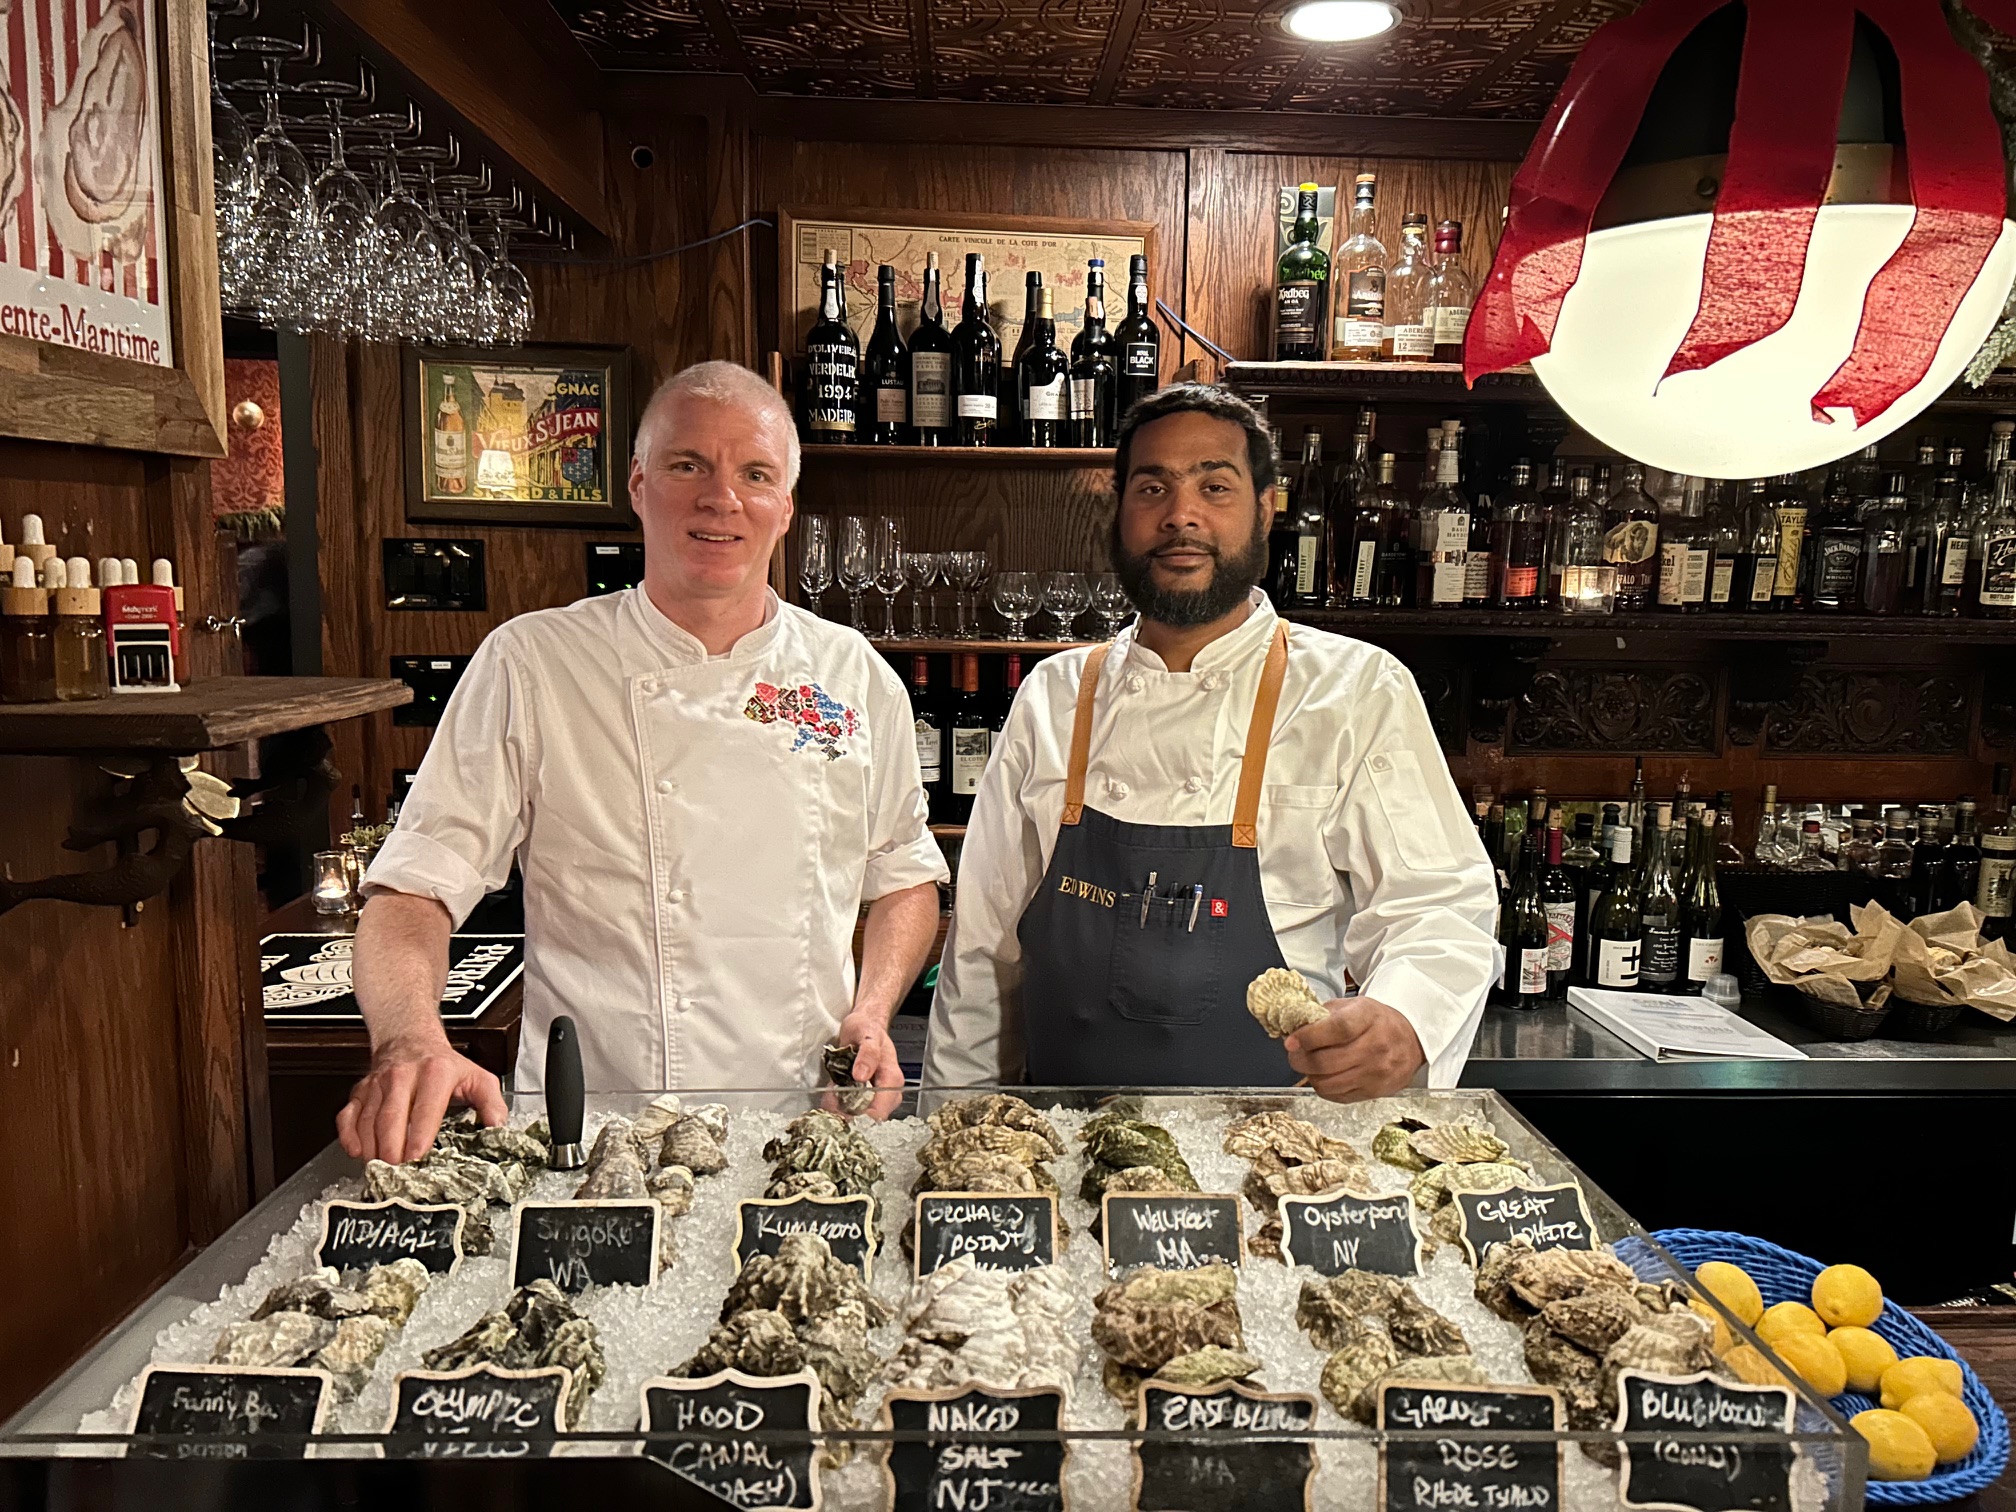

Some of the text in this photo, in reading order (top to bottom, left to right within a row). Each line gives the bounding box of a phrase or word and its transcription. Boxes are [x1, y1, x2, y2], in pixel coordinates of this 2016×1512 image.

[938, 235, 961, 244] CARTE
[963, 236, 994, 245] VINICOLE
[996, 238, 1006, 246] DE
[1041, 240, 1058, 248] D'OR
[1278, 287, 1310, 300] Ardbeg
[1129, 355, 1154, 365] BLACK
[1397, 342, 1408, 351] 12
[808, 362, 856, 379] VERDELH
[817, 384, 853, 401] 1994
[549, 412, 599, 437] JEAN
[808, 408, 856, 425] MADEIRA
[548, 490, 557, 499] &
[562, 488, 603, 501] FILS
[1781, 514, 1806, 525] TAYLO
[1057, 875, 1117, 909] EDWINS
[1214, 901, 1225, 915] &
[1476, 1197, 1556, 1224] GREAT
[1155, 1236, 1201, 1268] MA
[1332, 1236, 1360, 1269] NY
[549, 1257, 594, 1290] WA
[677, 1398, 765, 1432] HOOD
[927, 1402, 1021, 1433] NAKED
[1162, 1394, 1233, 1432] EAST
[936, 1443, 1024, 1471] SALT
[1435, 1438, 1519, 1473] ROSE
[935, 1476, 1004, 1512] NJ
[1413, 1476, 1480, 1509] RHODE
